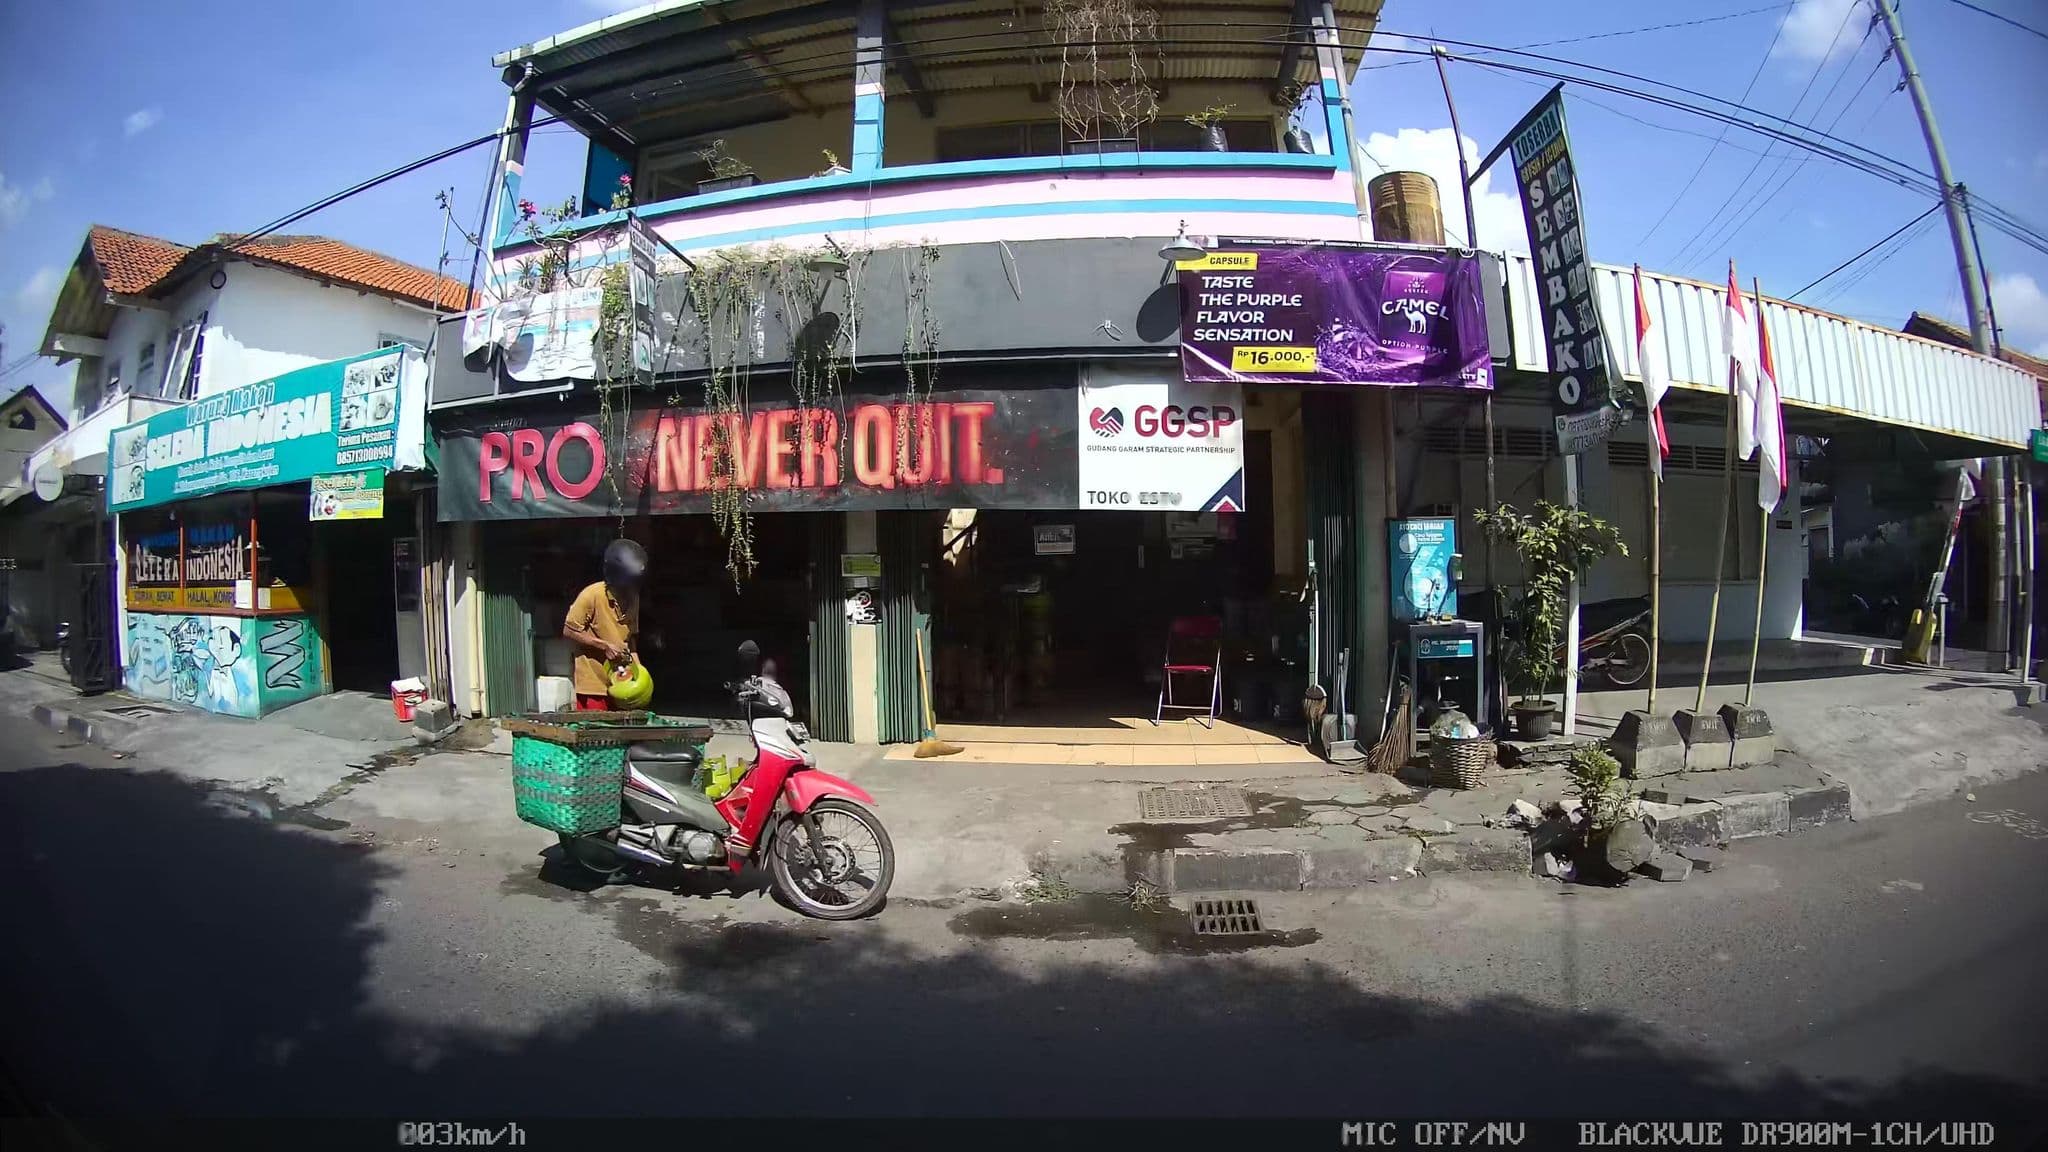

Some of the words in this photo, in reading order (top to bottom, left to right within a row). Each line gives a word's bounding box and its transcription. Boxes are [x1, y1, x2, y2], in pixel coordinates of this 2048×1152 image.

[1515, 110, 1558, 161] TOSERBA
[1209, 256, 1250, 265] CAPSULE
[1201, 276, 1254, 289] TASTE
[1529, 179, 1581, 405] SEMBAKO
[1199, 293, 1234, 306] THE
[1237, 294, 1303, 307] PURPLE
[1381, 298, 1449, 321] CAMEL
[1196, 311, 1265, 324] FLAVOR
[1193, 328, 1293, 342] SENSATION
[1134, 405, 1236, 438] GGSP
[657, 408, 839, 493] NEVER
[1087, 444, 1117, 452] GUDANG
[479, 421, 606, 503] PRO
[1087, 490, 1131, 505] TOKO
[186, 535, 245, 580] INDONESIA
